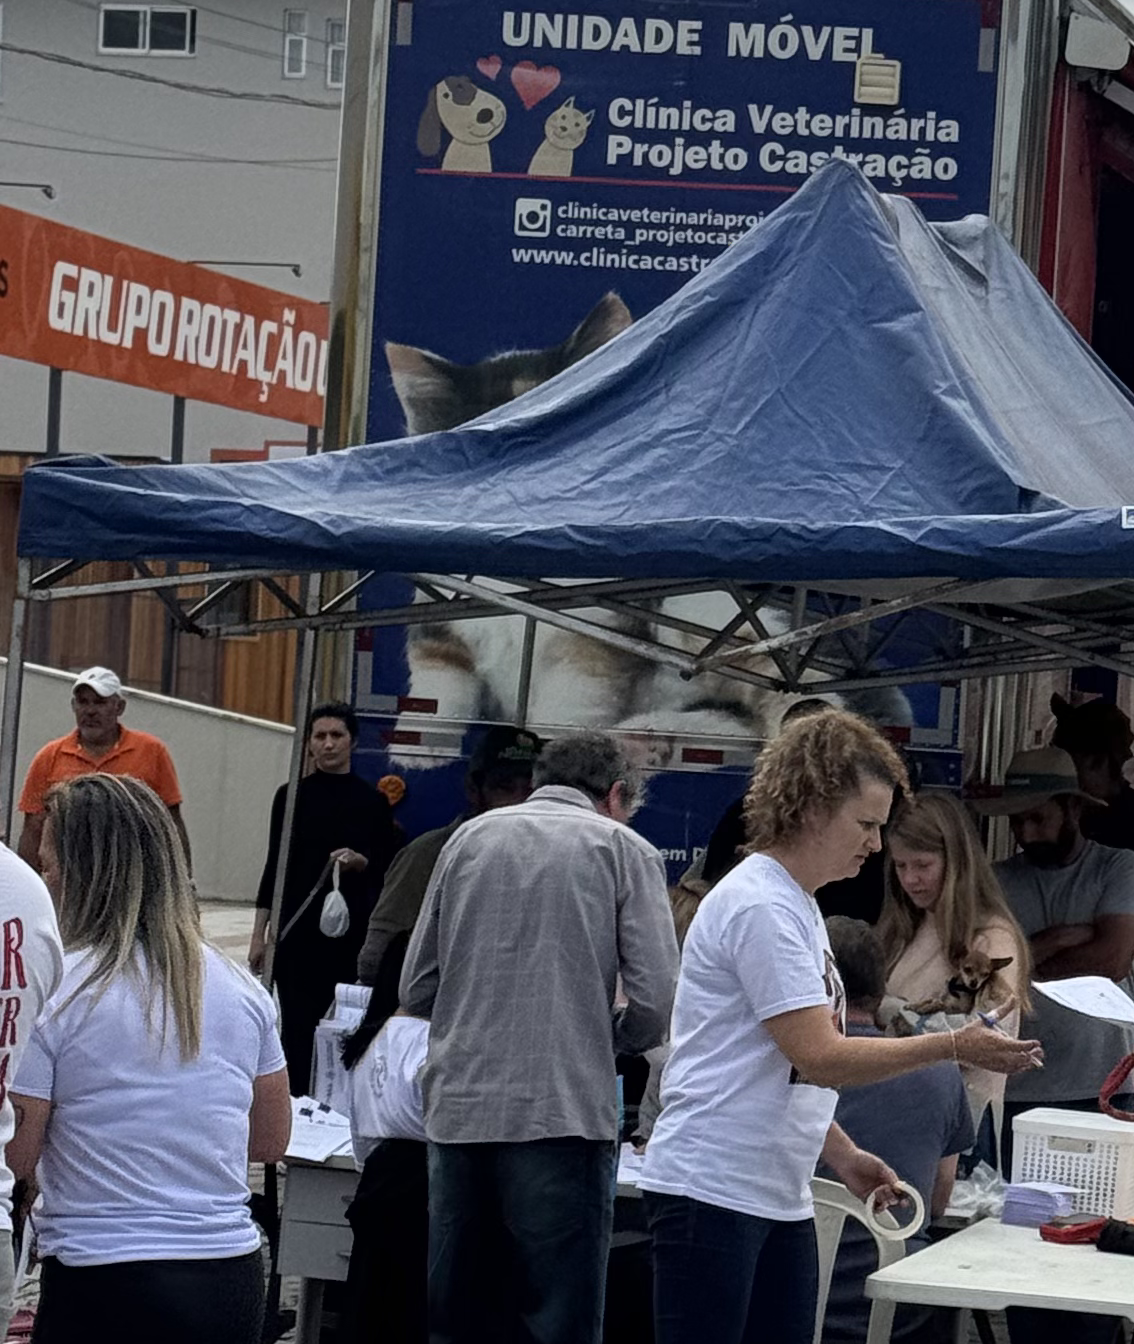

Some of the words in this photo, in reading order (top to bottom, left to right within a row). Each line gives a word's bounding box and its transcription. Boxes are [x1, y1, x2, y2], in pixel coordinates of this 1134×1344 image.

[502, 11, 703, 55] UNIDADE
[727, 14, 884, 62] MÓVEL
[608, 97, 736, 134] Clínica
[748, 103, 960, 143] Veterinária
[606, 135, 748, 176] Projeto
